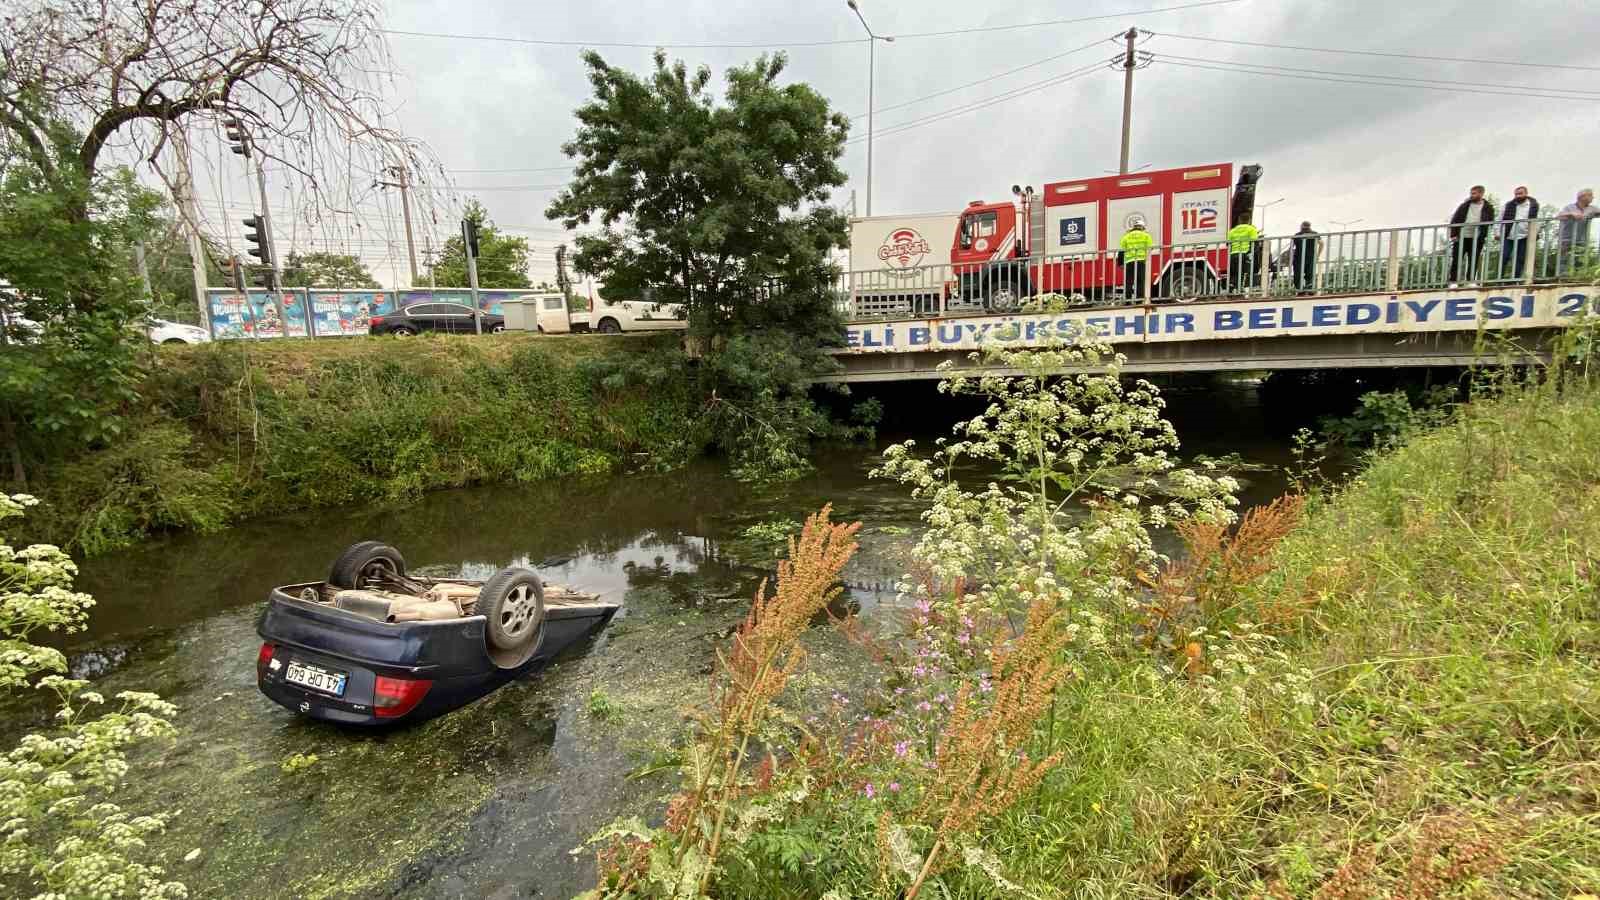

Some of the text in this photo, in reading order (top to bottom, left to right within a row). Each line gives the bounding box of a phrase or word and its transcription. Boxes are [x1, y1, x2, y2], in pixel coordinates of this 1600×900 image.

[1182, 208, 1218, 230] 112
[1214, 291, 1535, 331] BELEDİYESİ
[288, 667, 304, 681] 640
[307, 671, 323, 687] DR
[326, 676, 338, 690] 41
